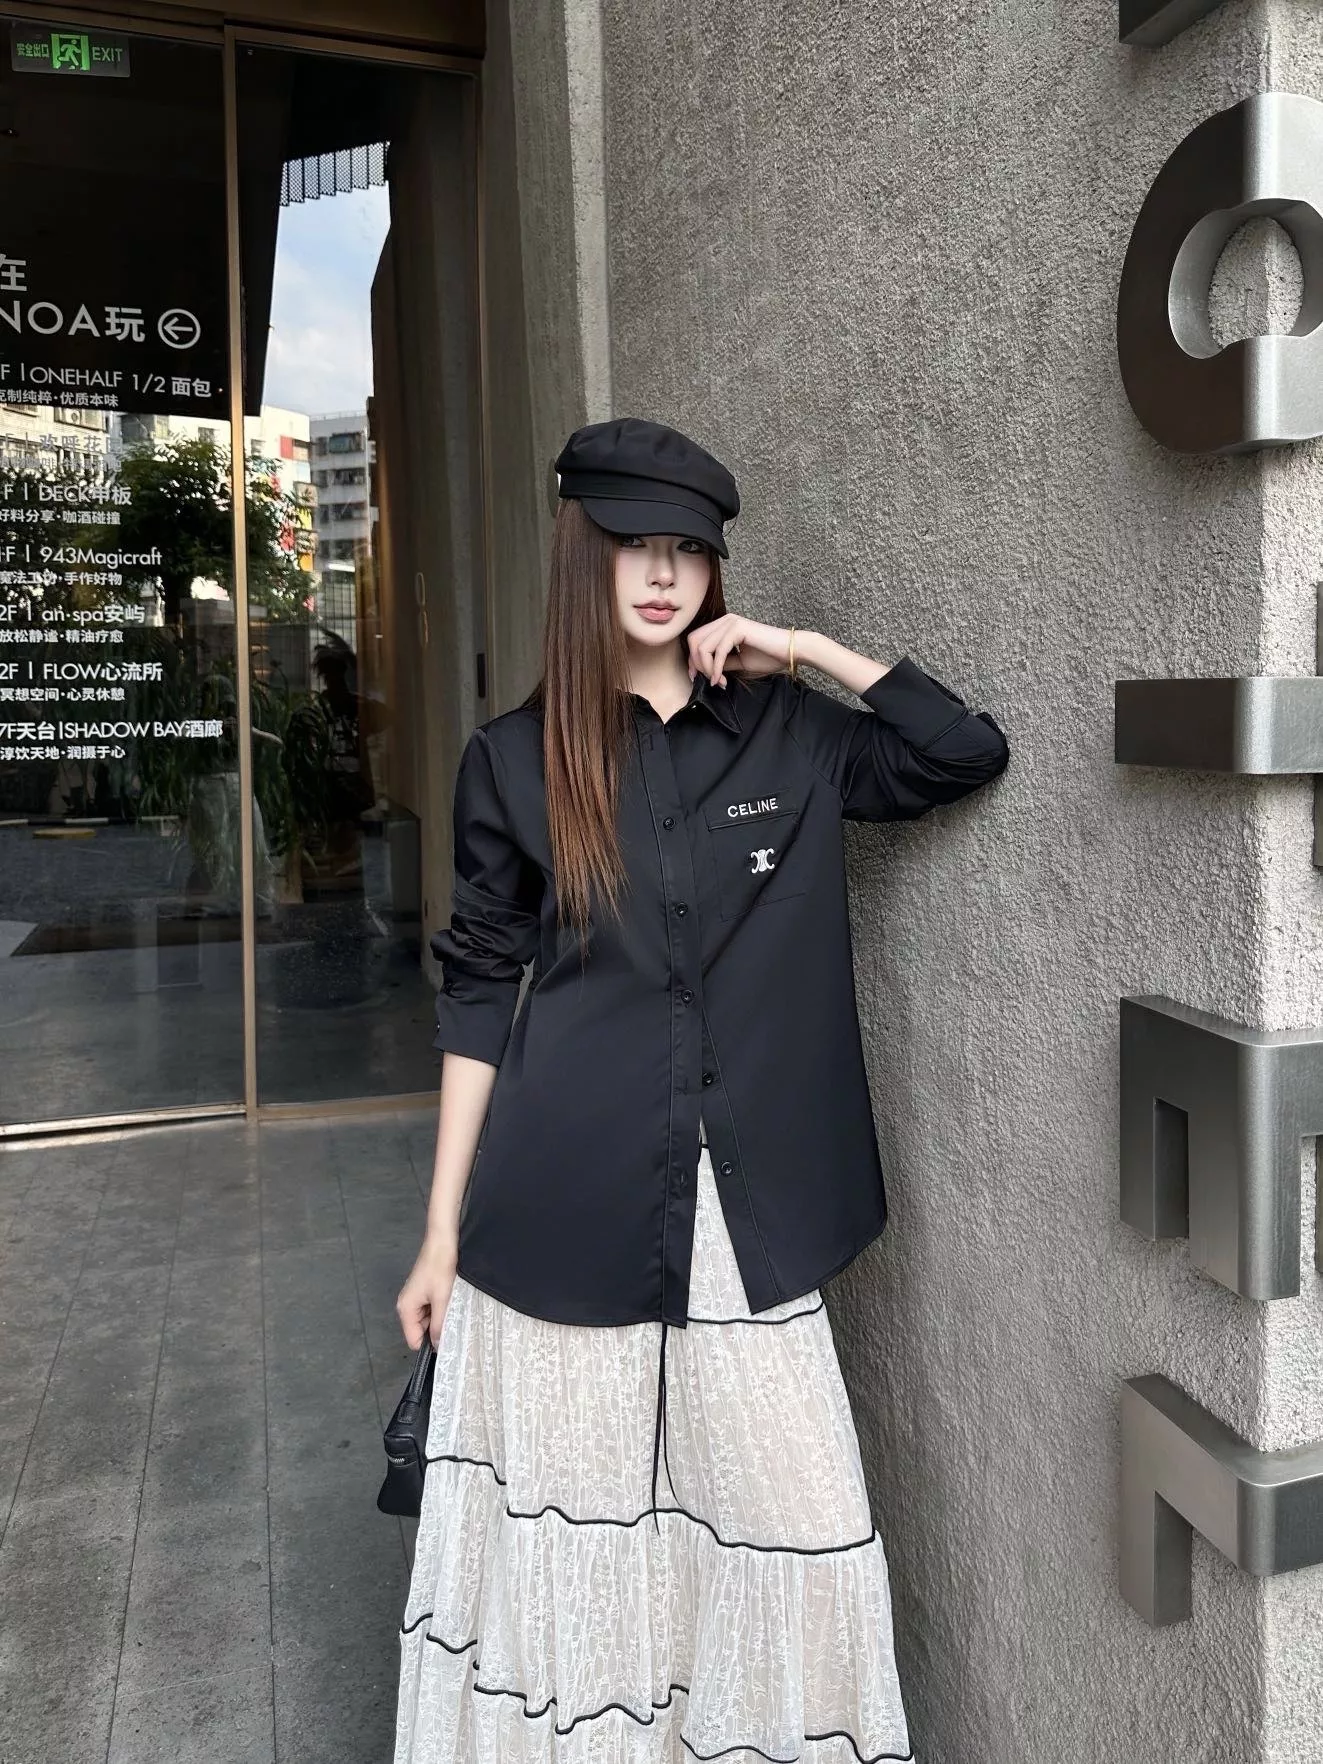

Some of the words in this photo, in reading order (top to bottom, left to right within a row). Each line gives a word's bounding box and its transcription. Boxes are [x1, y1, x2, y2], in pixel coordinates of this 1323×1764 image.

[92, 46, 123, 62] EXIT
[0, 253, 27, 291] 在
[0, 300, 146, 342] NOA玩
[132, 373, 166, 394] 1/2
[171, 376, 212, 397] 面包
[39, 485, 132, 505] DECK甲板
[40, 546, 162, 569] 943Magicraft
[0, 604, 17, 622] 2F
[0, 663, 18, 680] 2F
[43, 662, 162, 681] FLOW心流所
[154, 719, 223, 738] BAY酒廊
[727, 797, 778, 818] CELINE
[1115, 0, 1323, 1627] OTEL
